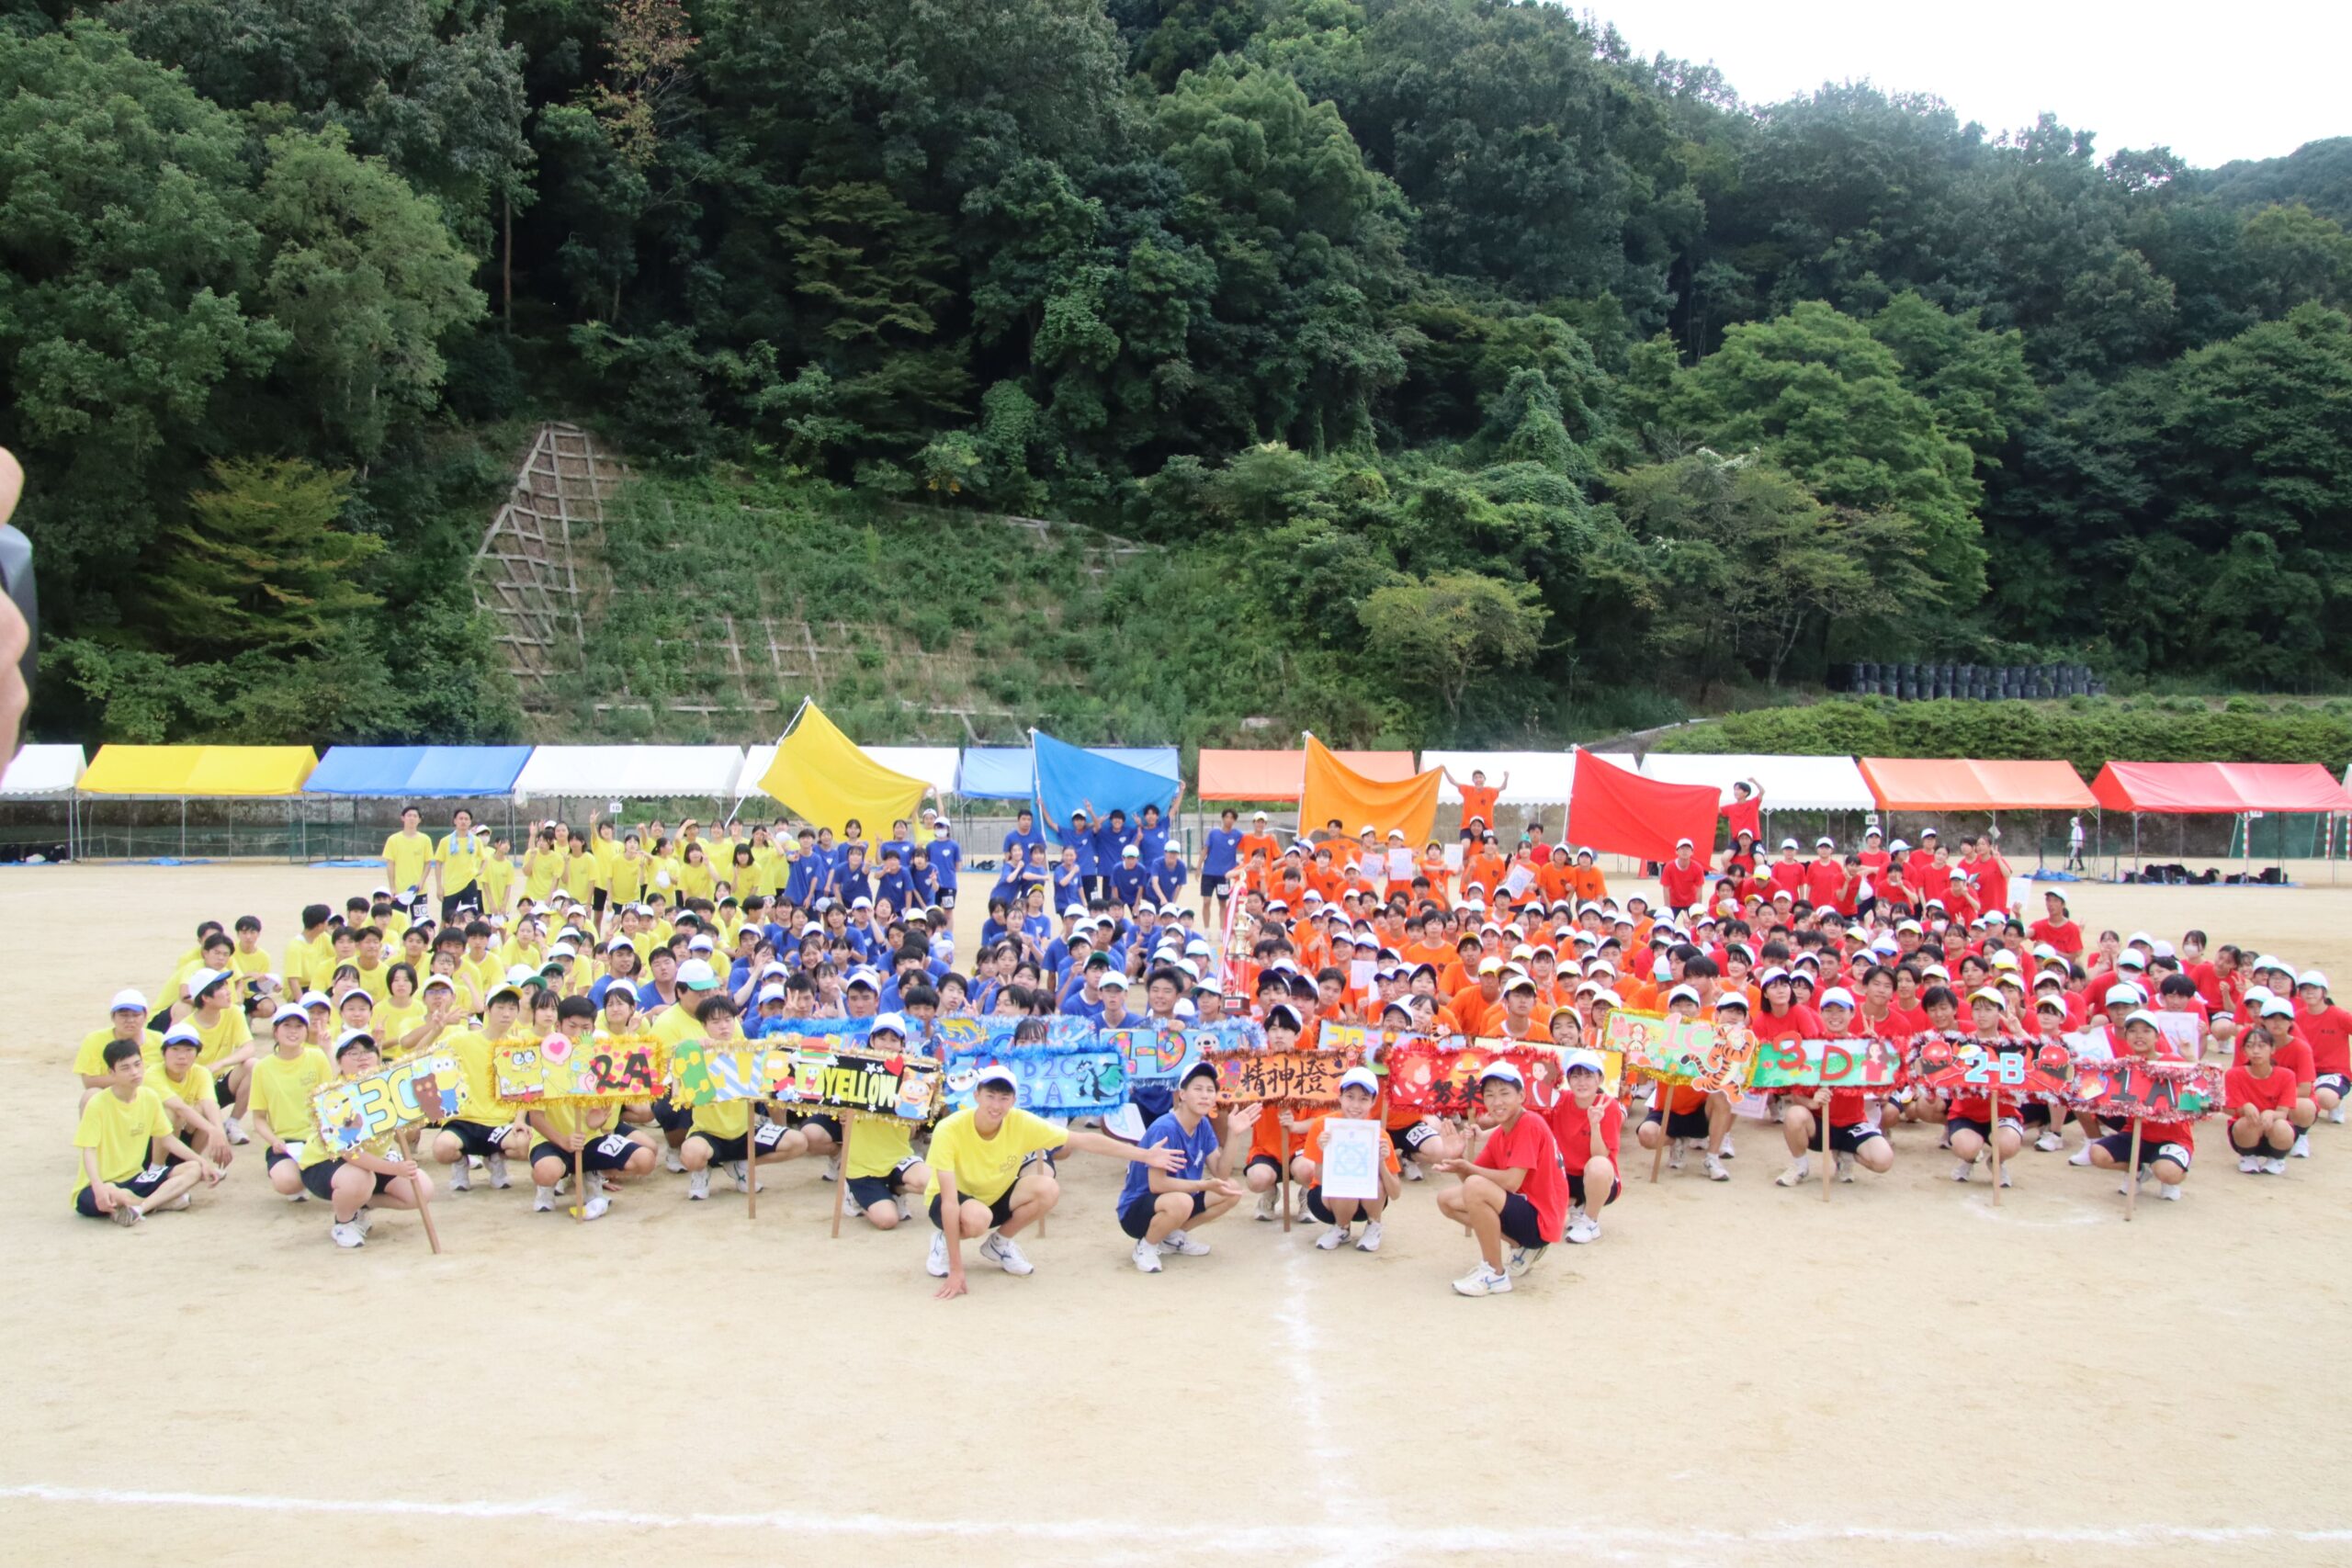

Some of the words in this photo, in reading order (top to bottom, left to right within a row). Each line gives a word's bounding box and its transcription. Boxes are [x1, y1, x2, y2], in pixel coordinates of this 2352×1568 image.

[1660, 1012, 1713, 1054] 1C
[589, 1053, 652, 1089] 2A
[1772, 1030, 1853, 1081] 3D
[1963, 1051, 2025, 1085] 2-B
[358, 1065, 427, 1135] 3C
[823, 1066, 899, 1108] YELLOW
[2109, 1066, 2177, 1109] 1A
